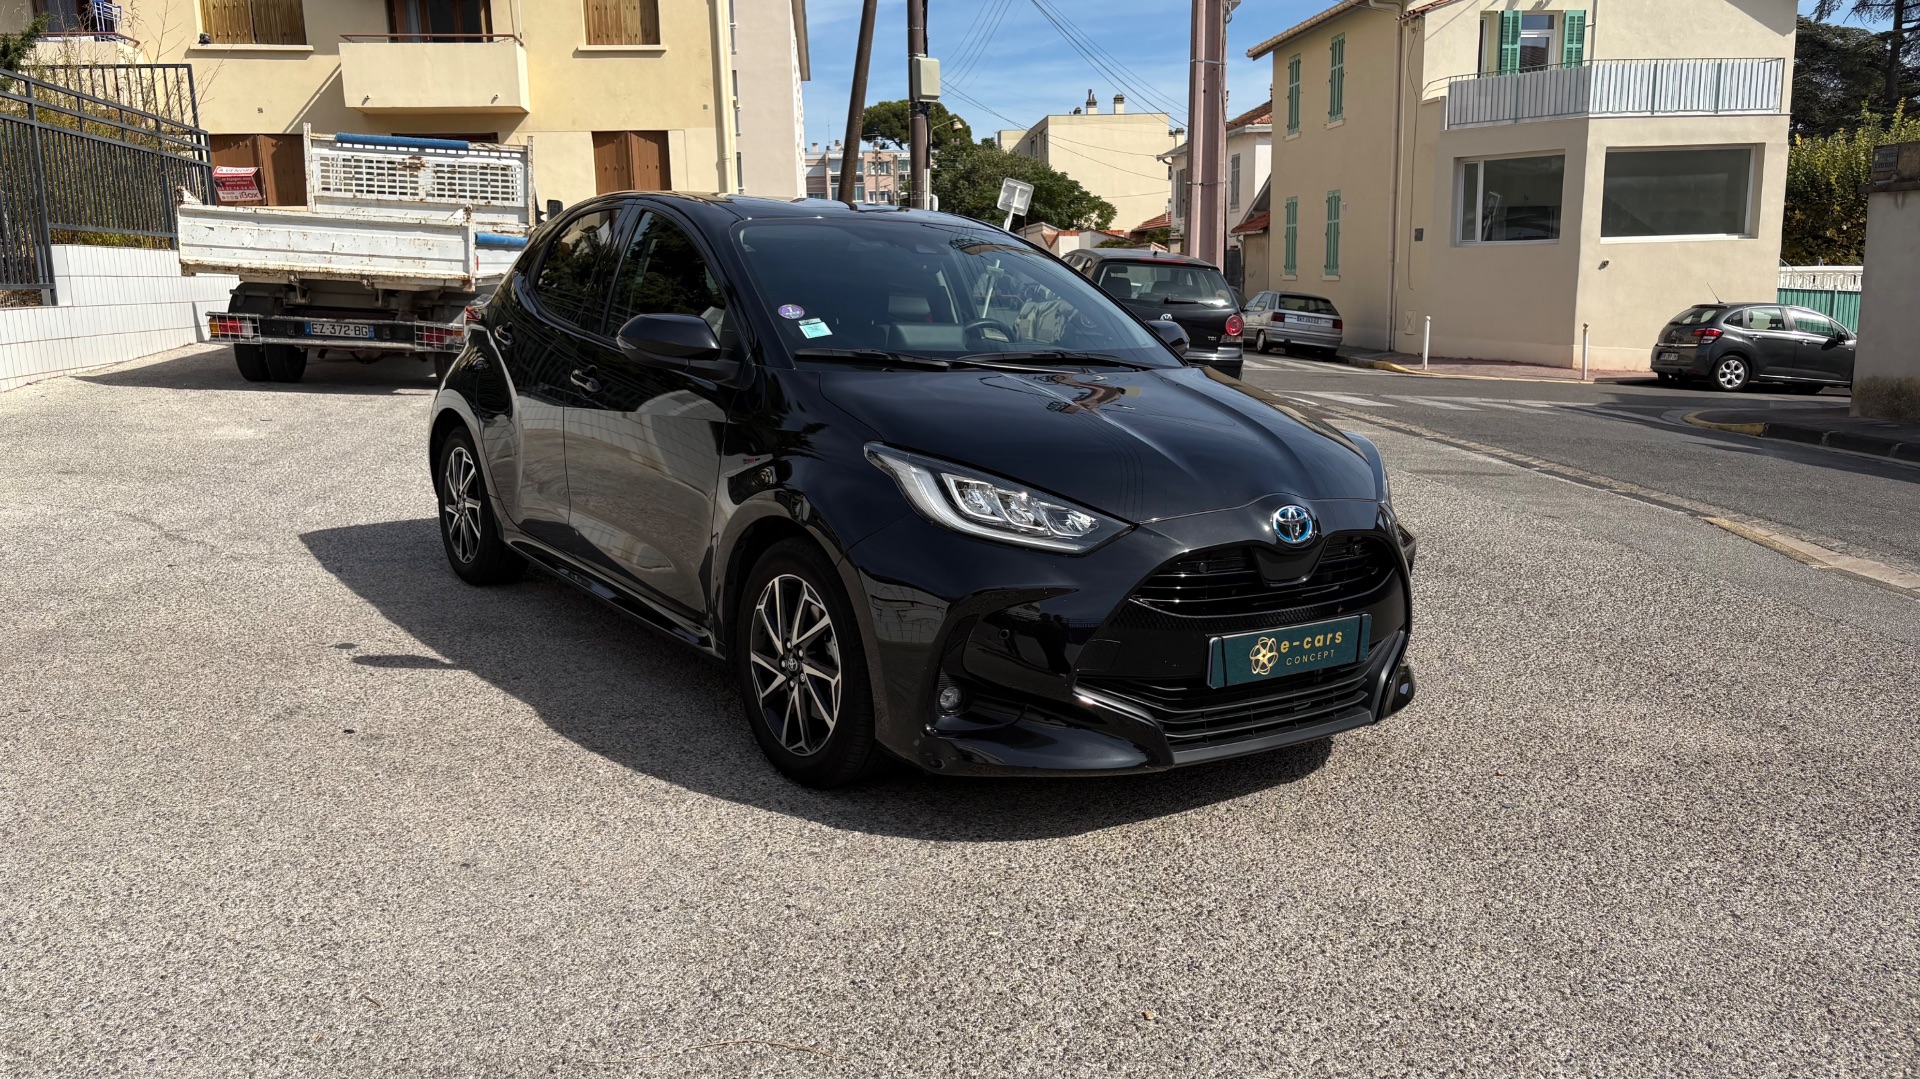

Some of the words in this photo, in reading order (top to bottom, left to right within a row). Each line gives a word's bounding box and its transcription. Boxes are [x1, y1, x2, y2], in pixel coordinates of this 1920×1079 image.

[311, 322, 368, 337] EZ-372-BG
[1280, 631, 1343, 653] e-cars
[1286, 649, 1335, 666] CONCEPT
